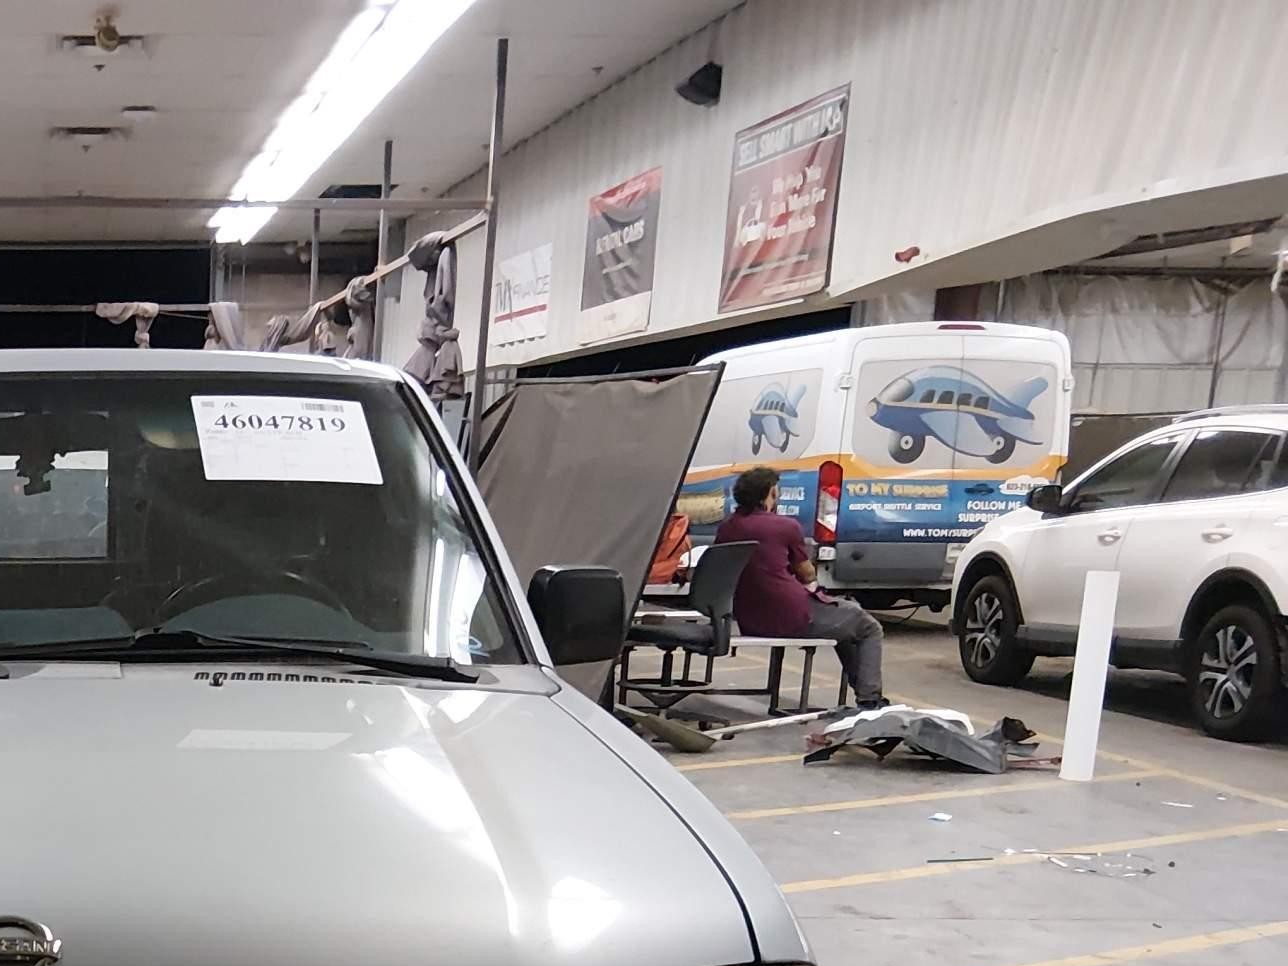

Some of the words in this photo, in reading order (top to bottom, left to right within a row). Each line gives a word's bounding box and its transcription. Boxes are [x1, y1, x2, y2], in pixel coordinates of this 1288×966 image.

[214, 413, 346, 433] 46047819
[847, 483, 868, 496] TO
[871, 483, 888, 496] MY
[967, 500, 1006, 511] FOLLOW
